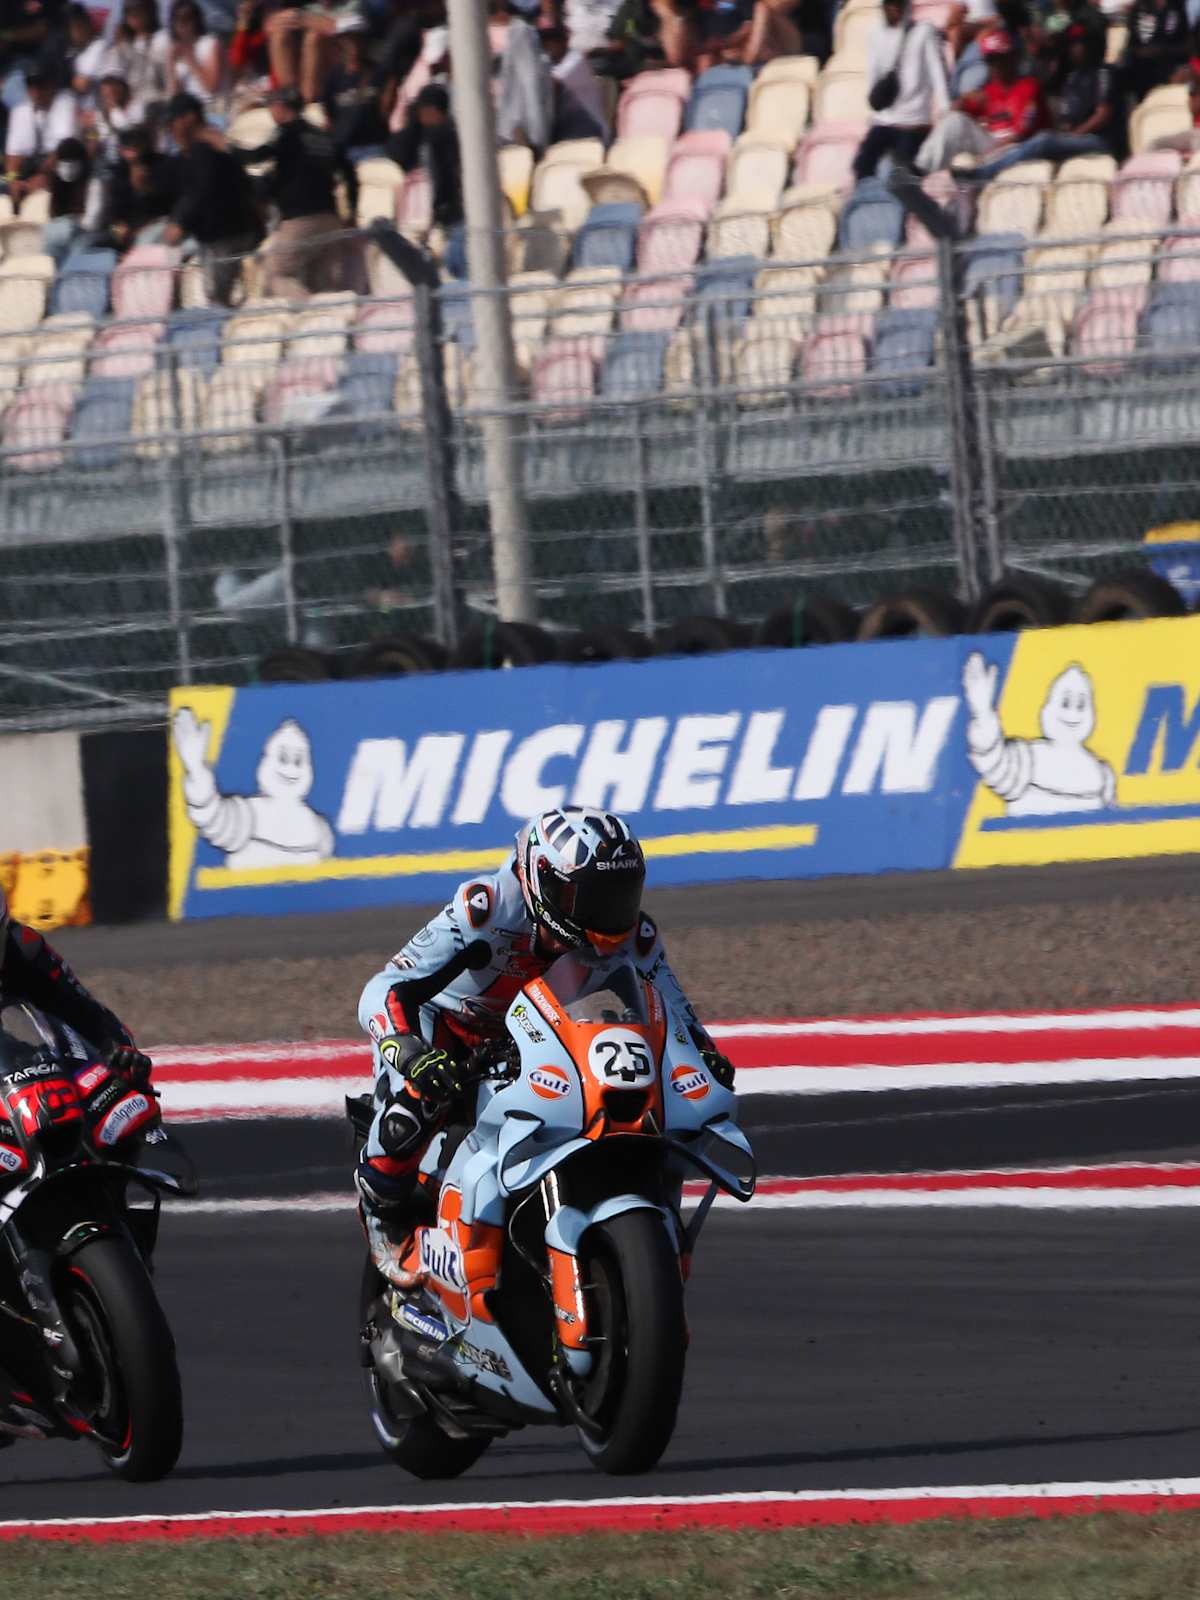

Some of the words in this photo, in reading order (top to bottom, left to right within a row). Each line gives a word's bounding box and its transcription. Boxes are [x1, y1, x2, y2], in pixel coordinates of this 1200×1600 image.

[338, 696, 958, 835] MICHELIN
[595, 860, 639, 871] SHARK
[595, 1041, 650, 1082] 25
[529, 1070, 571, 1094] Gulf
[671, 1071, 709, 1094] Gulf
[421, 1229, 468, 1289] Gulf
